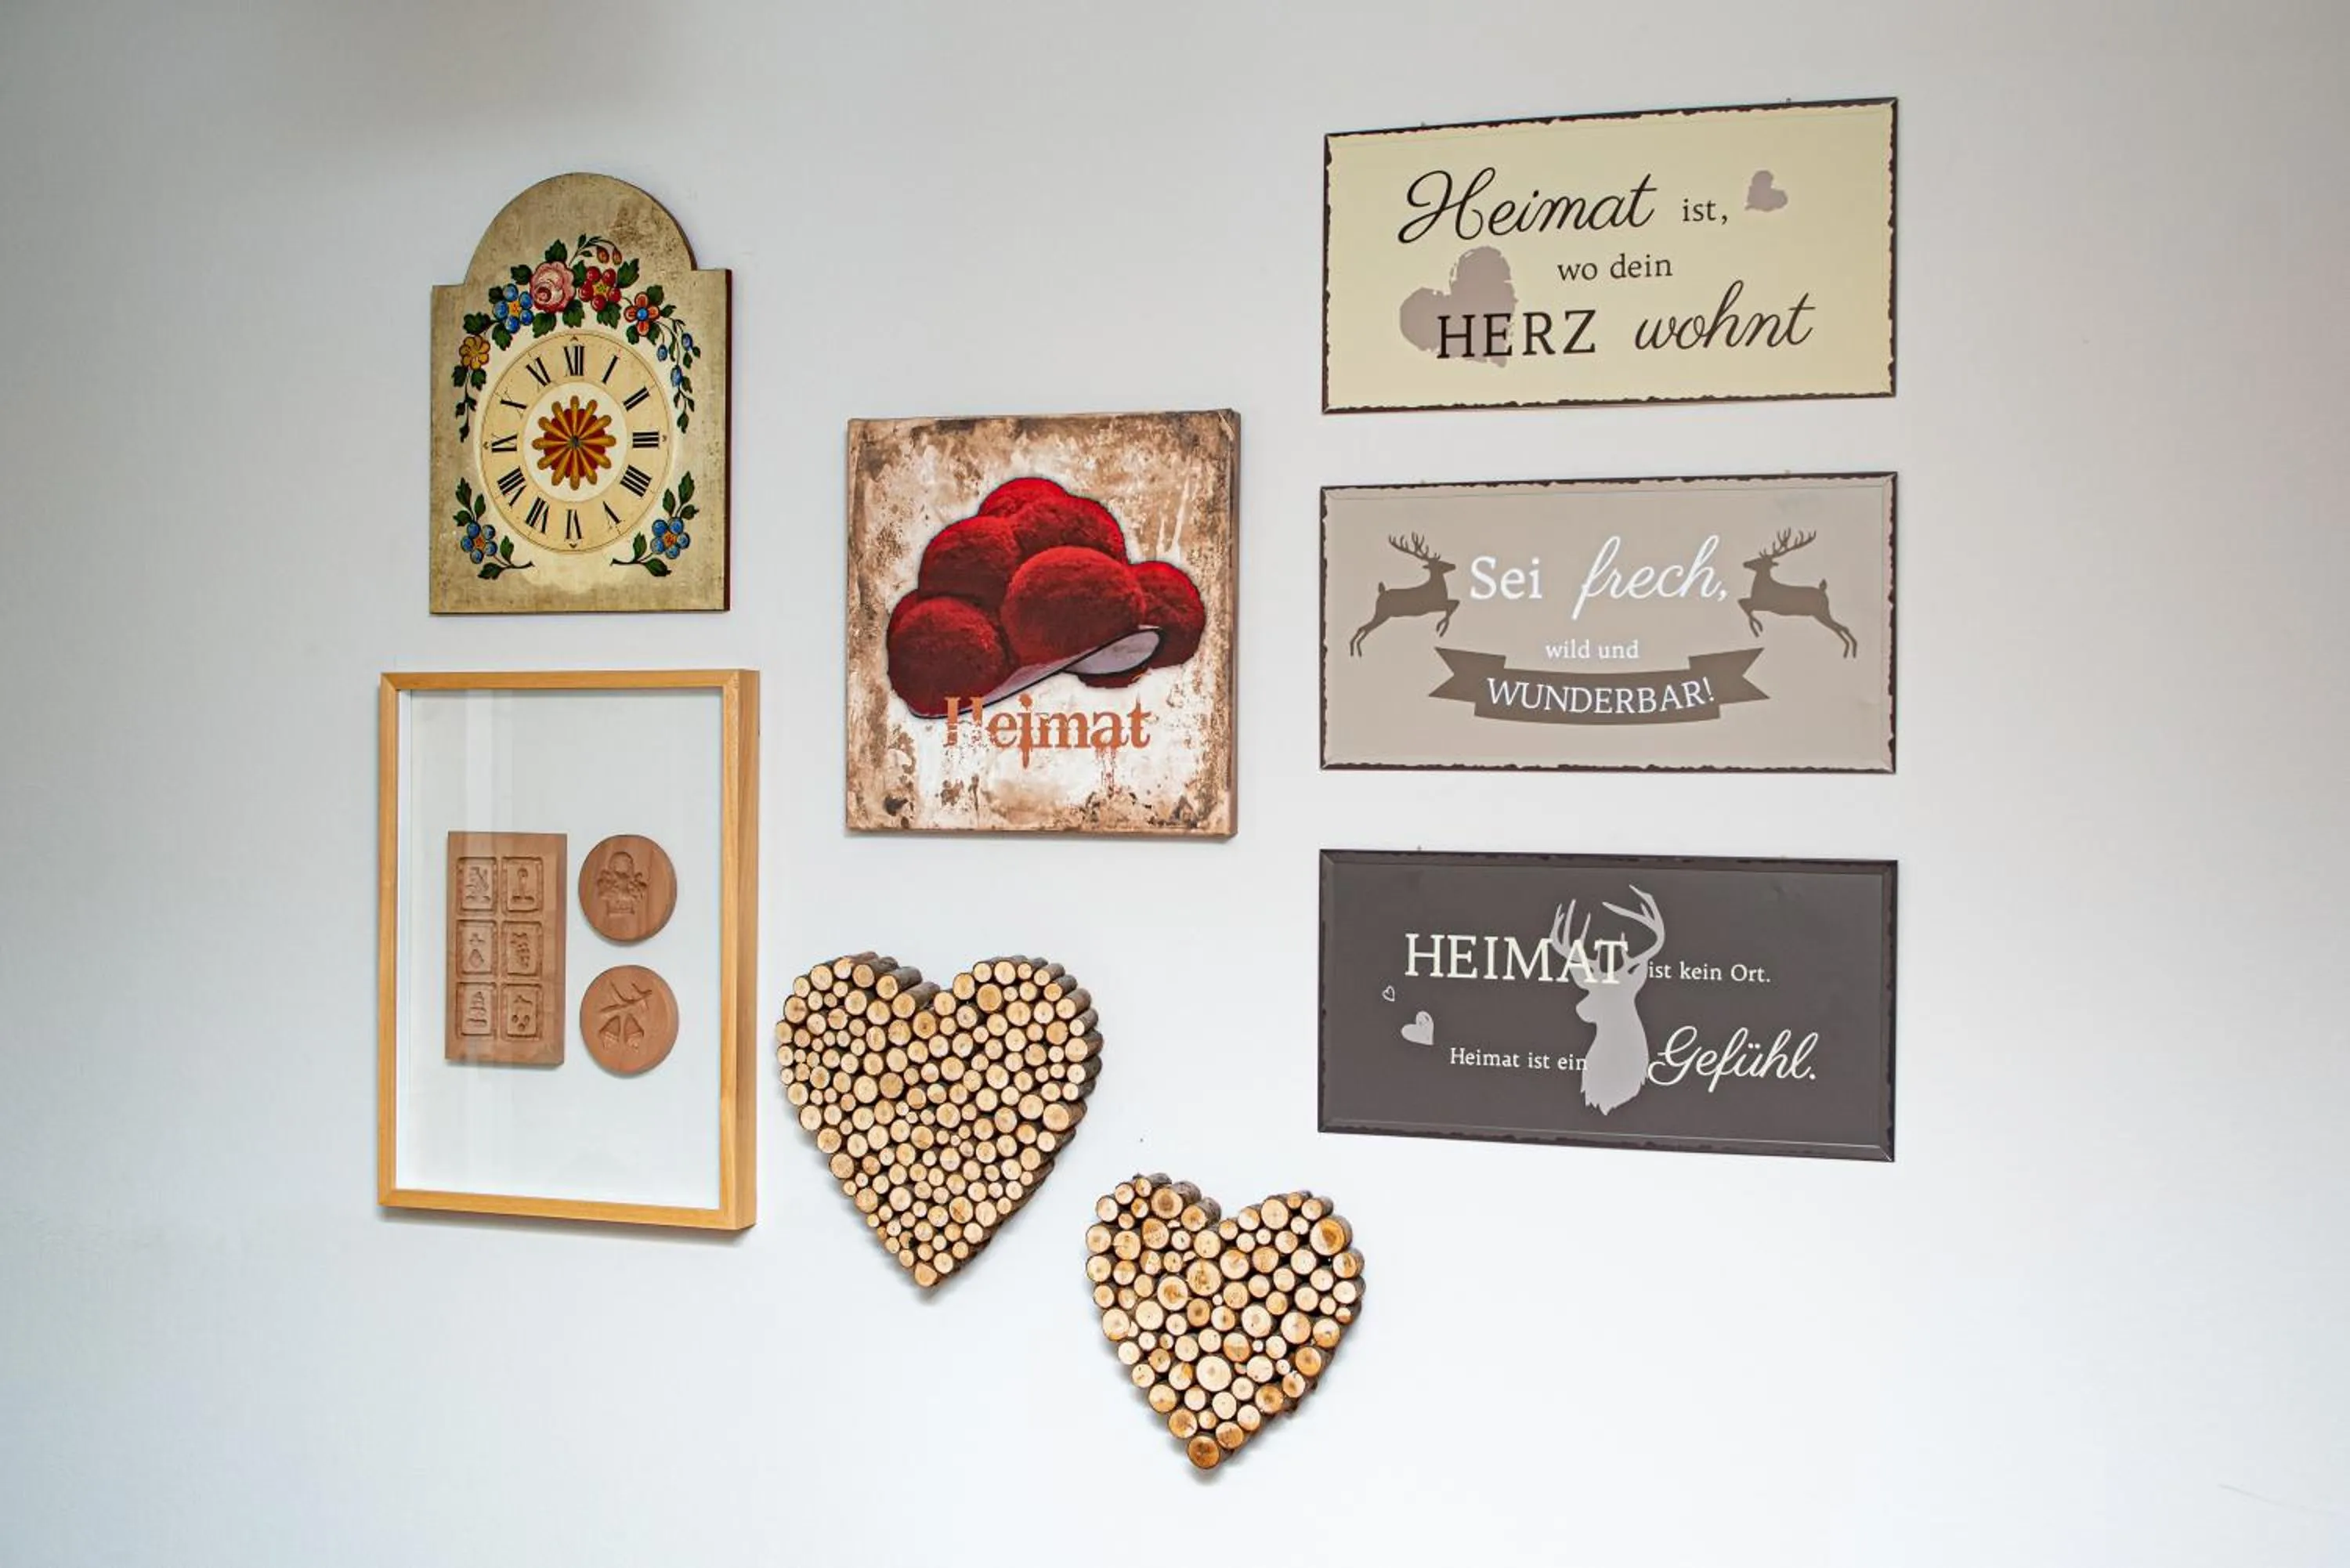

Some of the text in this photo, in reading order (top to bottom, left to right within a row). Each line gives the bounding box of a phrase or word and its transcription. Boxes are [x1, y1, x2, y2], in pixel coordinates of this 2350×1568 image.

[1397, 167, 1729, 244] Heimat ist,
[1556, 254, 1673, 280] wo dein
[1437, 280, 1817, 358] HERZ wohnt
[1470, 534, 1729, 620] Sei frech,
[1546, 639, 1640, 659] wild und
[1488, 677, 1716, 714] WUNDERBAR!
[944, 692, 1152, 768] Heimat
[1405, 933, 1771, 984] HEIMAT ist kein Ort.
[1450, 1026, 1819, 1093] Heimat ist ein Gefühl.
